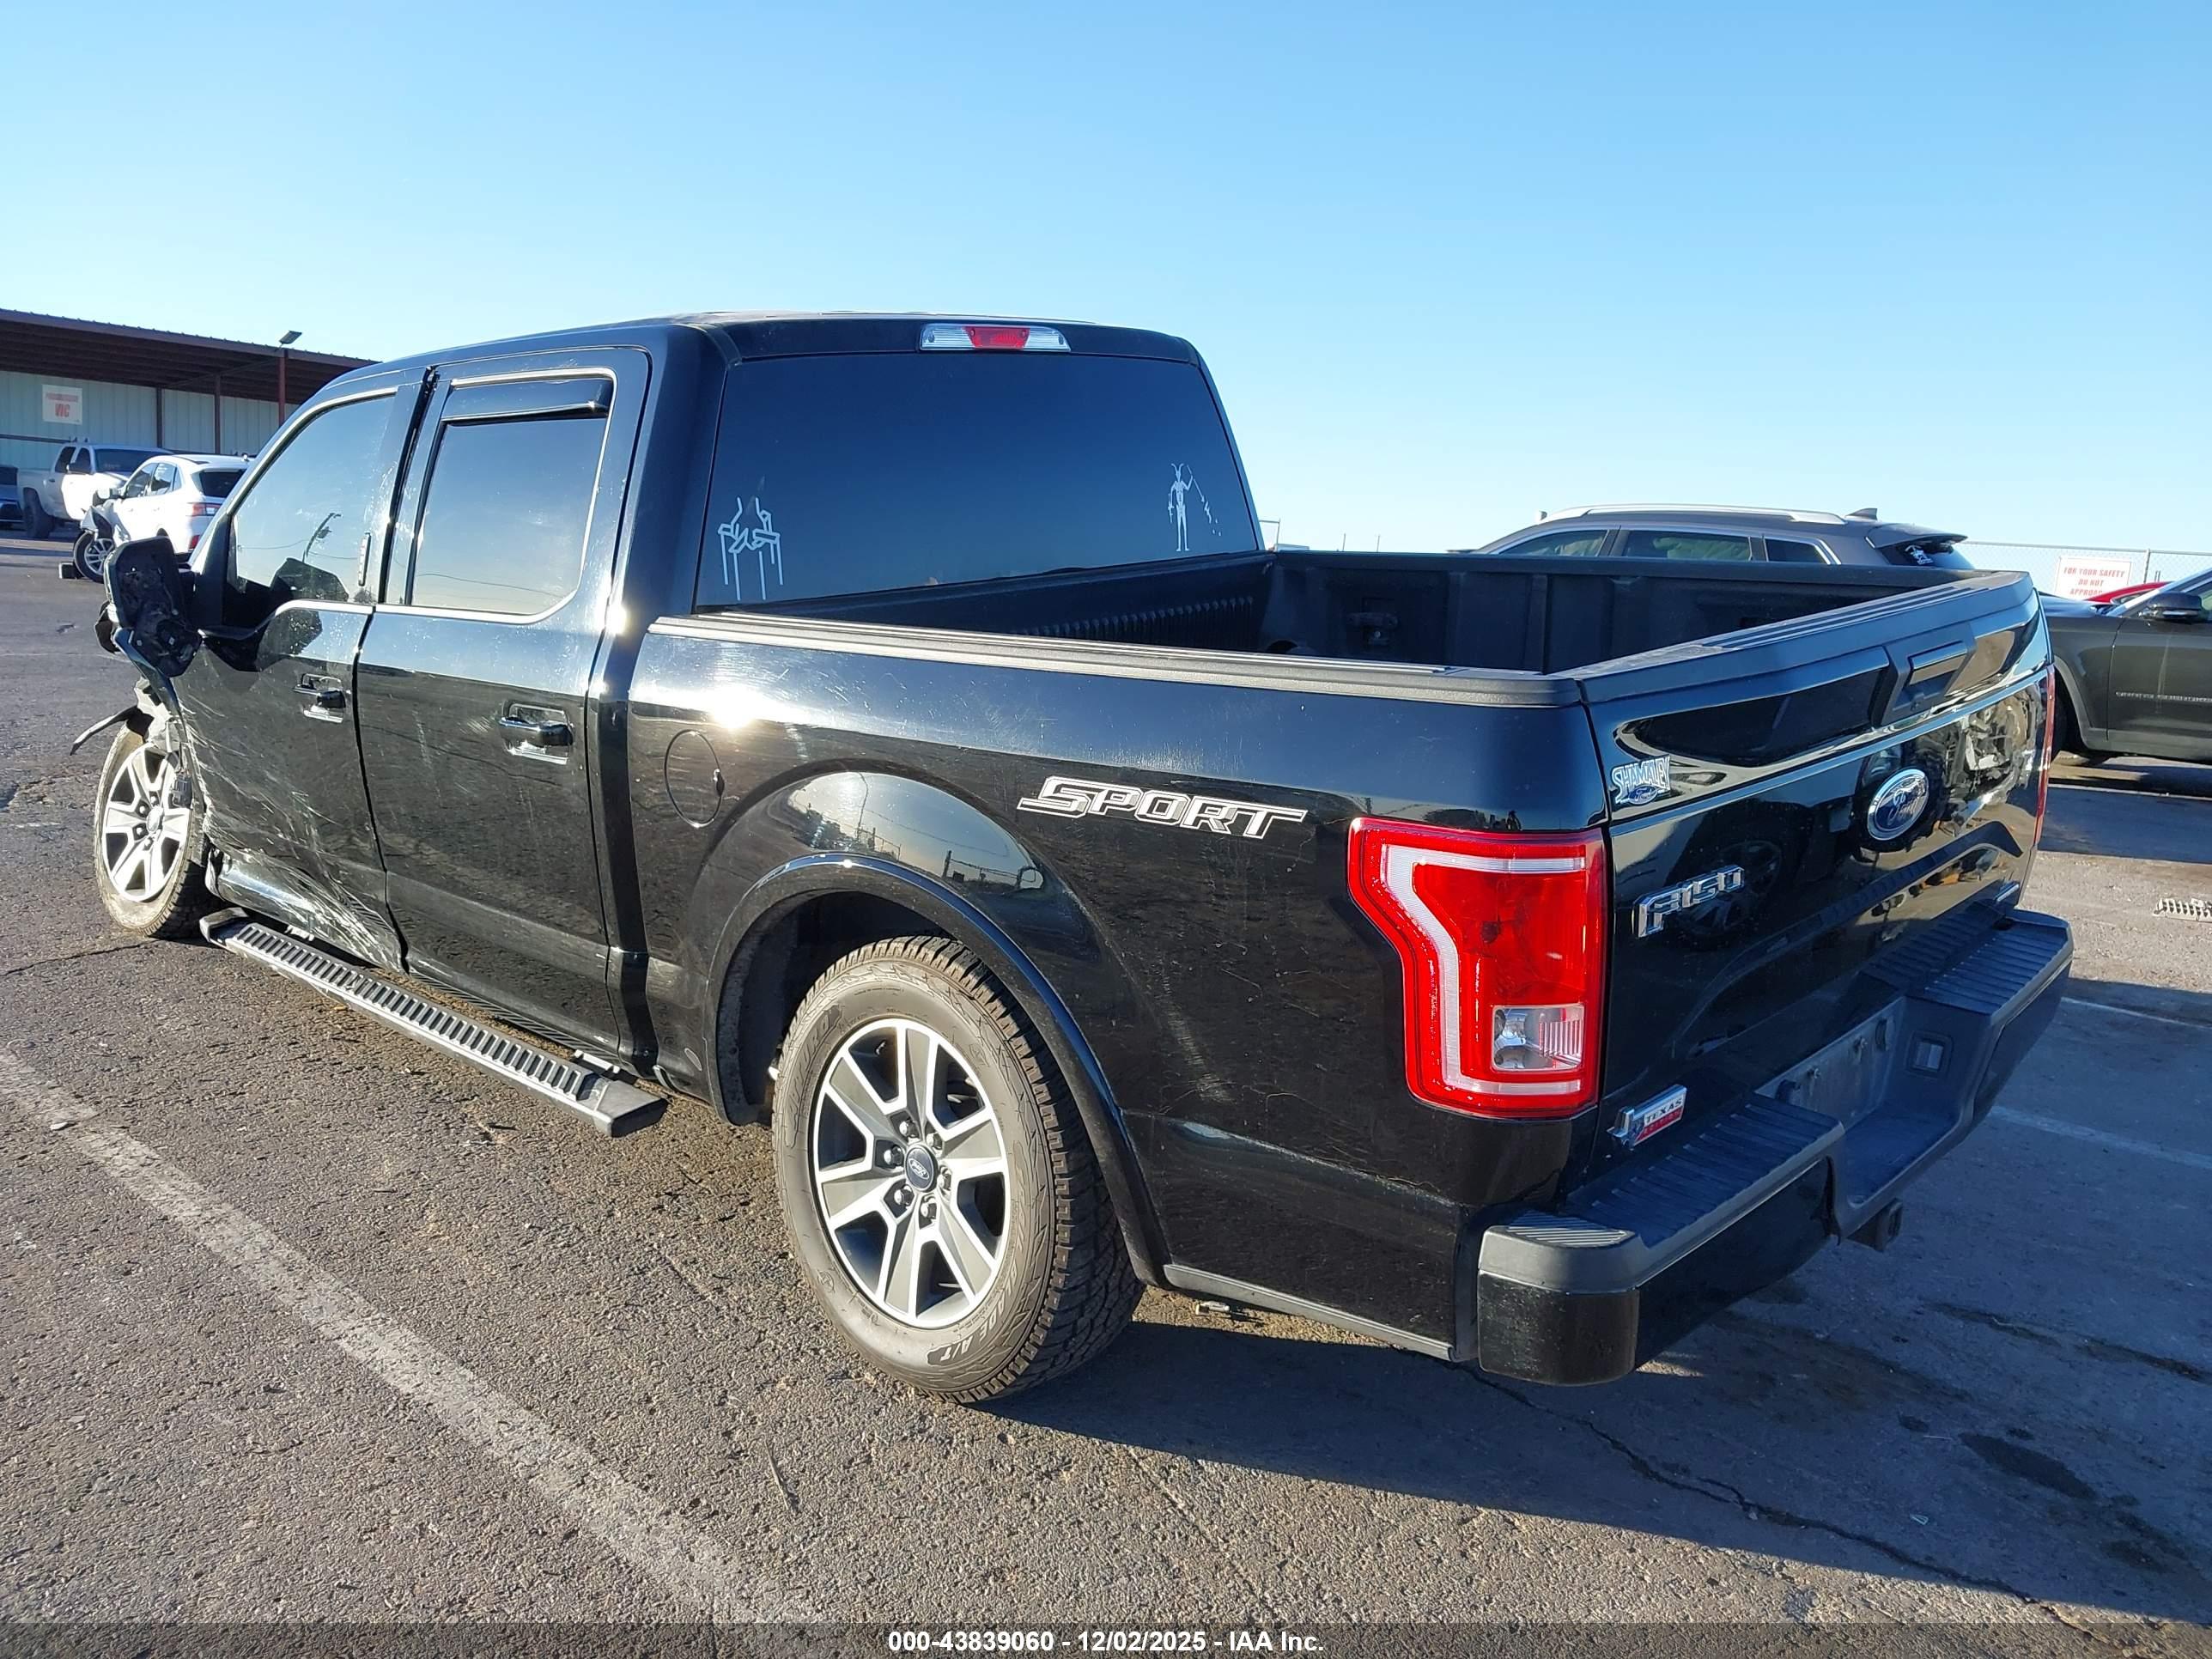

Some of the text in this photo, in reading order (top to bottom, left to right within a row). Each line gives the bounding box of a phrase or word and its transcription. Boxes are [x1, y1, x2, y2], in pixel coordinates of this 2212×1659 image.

[2079, 568, 2097, 576] YOUR
[2099, 569, 2125, 578] SAFETY
[1612, 756, 1671, 804] SHAMALEY
[1017, 775, 1308, 839] SPORT
[1632, 786, 1656, 803] Ford
[1644, 1098, 1683, 1122] TEXAS
[978, 1260, 1018, 1341] BLADE
[940, 1335, 974, 1362] A/T
